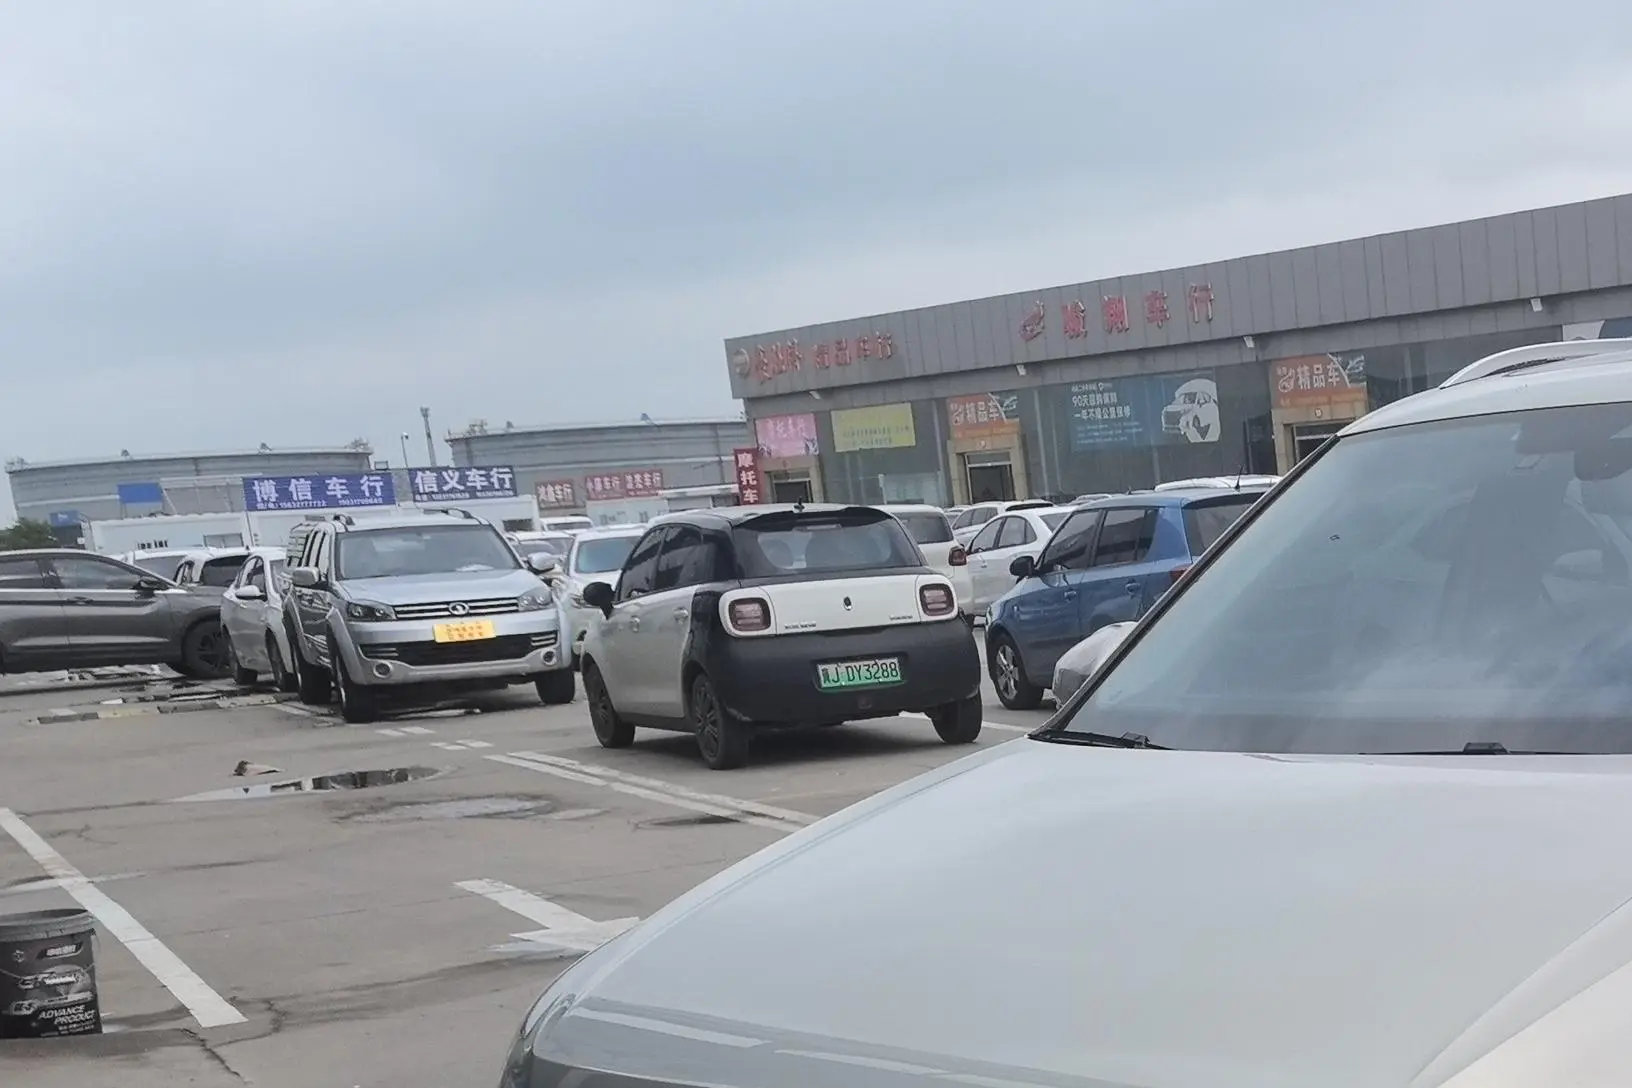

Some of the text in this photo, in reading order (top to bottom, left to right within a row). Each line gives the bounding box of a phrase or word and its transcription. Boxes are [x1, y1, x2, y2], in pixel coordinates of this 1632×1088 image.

[1297, 362, 1340, 390] 精品车
[966, 399, 999, 425] 精品车
[252, 474, 385, 502] 博信车行
[415, 467, 514, 493] 信义车行
[736, 452, 759, 504] 摩托车
[38, 1004, 86, 1019] ADVANCE
[54, 1009, 96, 1025] PRODUCT
